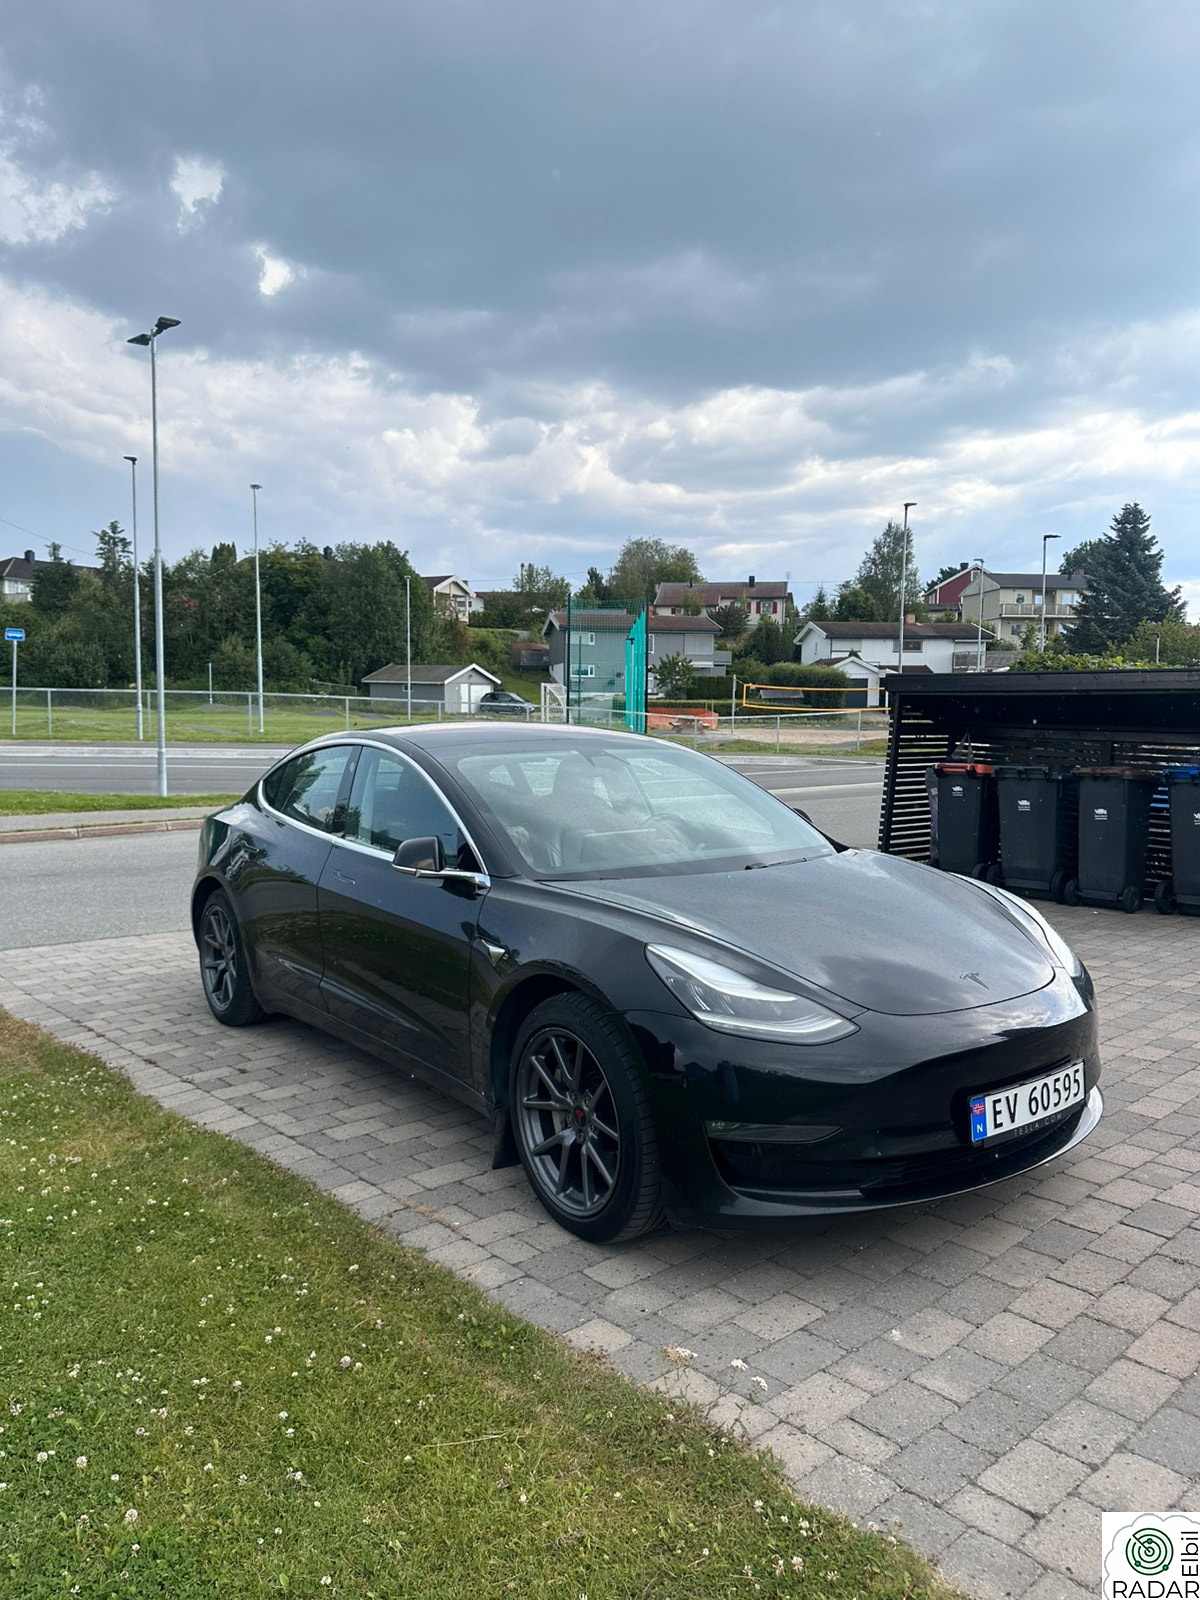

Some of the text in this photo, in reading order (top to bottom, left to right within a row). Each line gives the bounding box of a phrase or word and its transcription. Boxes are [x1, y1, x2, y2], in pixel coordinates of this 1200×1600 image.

[992, 1068, 1080, 1129] EV 60595
[976, 1123, 983, 1133] N
